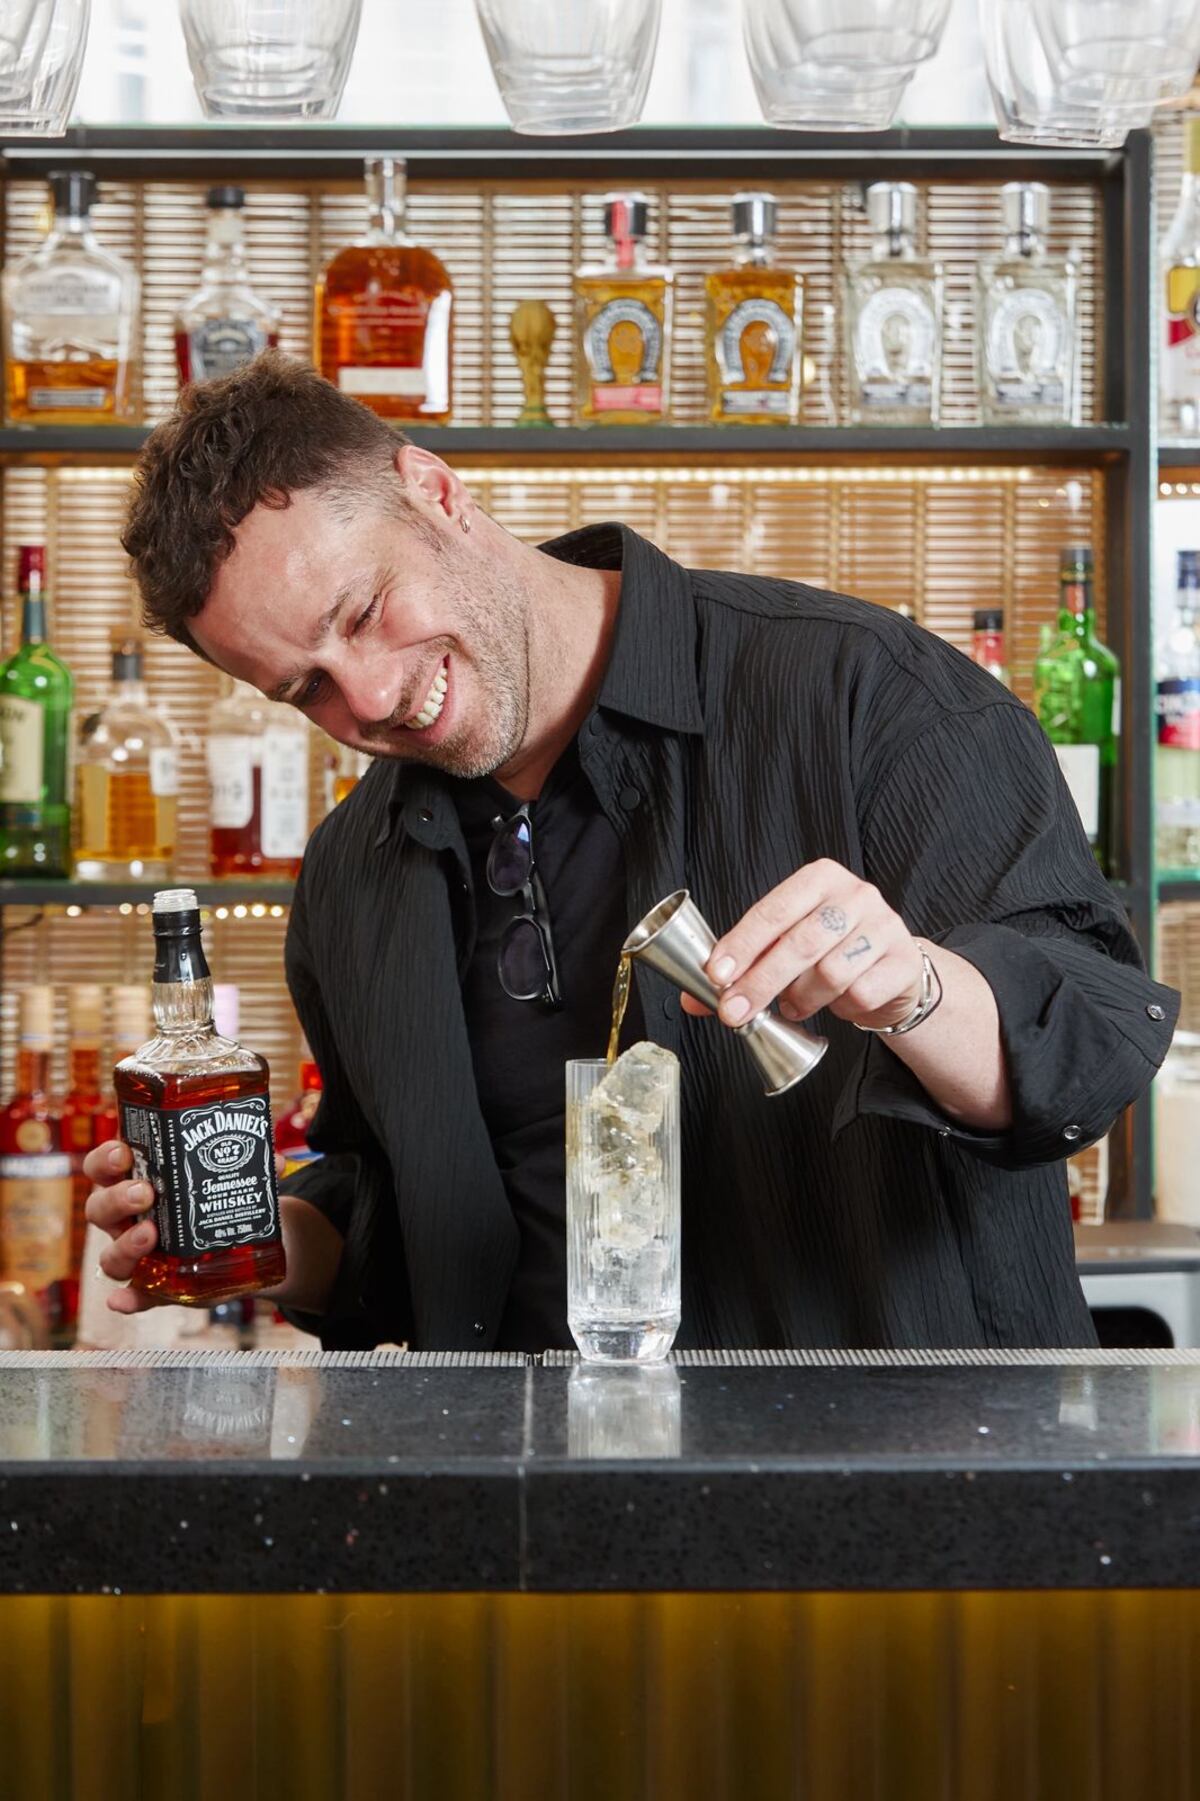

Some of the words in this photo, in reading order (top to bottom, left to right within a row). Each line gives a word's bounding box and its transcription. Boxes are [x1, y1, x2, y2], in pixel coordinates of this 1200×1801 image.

[167, 1119, 175, 1143] EVERY
[180, 1118, 217, 1152] JACK
[214, 1111, 269, 1140] DANIEL'S
[220, 1140, 233, 1148] OLD
[172, 1169, 180, 1189] MADE
[202, 1176, 258, 1195] Tennessee
[175, 1192, 180, 1202] IN
[199, 1191, 263, 1214] WHISKEY
[206, 1193, 228, 1201] SOUR
[230, 1187, 255, 1196] MASH
[176, 1204, 185, 1248] TENNESSEE
